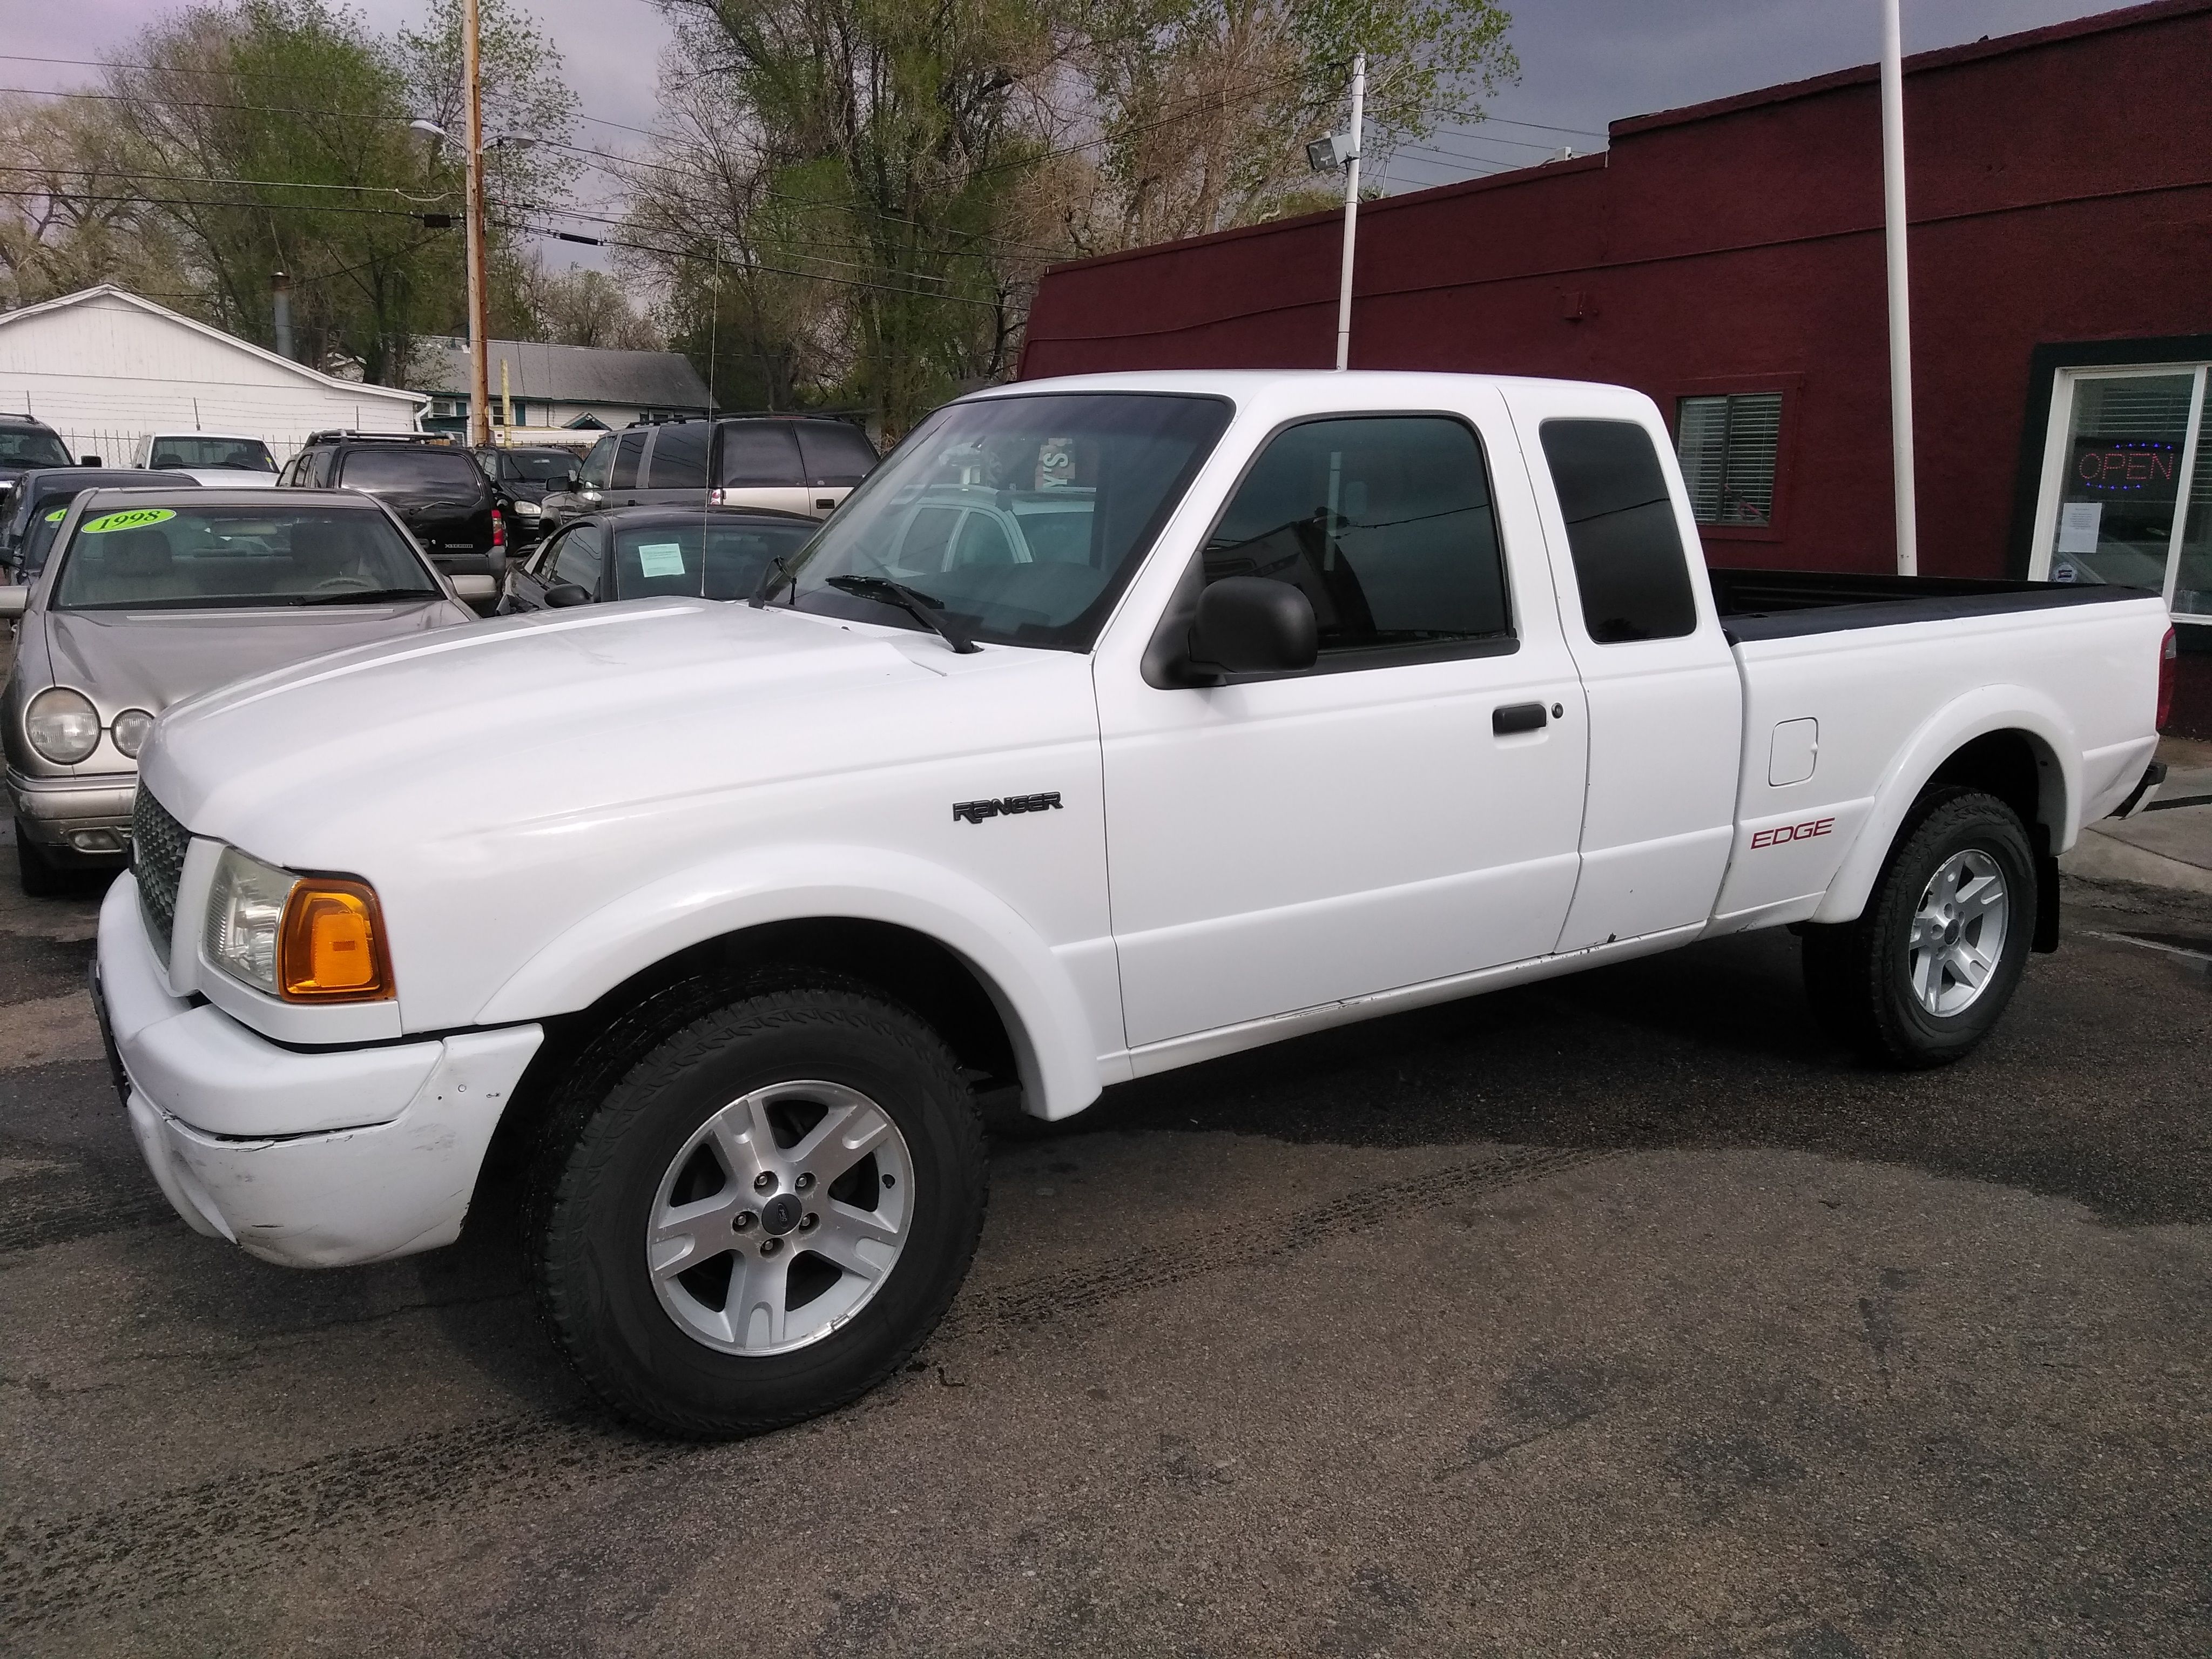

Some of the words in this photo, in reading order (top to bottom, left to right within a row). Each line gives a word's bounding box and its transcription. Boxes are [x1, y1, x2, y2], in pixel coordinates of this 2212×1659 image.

[2079, 453, 2174, 480] OPEN
[96, 510, 161, 530] 1998
[953, 791, 1064, 824] RANGER
[1750, 817, 1836, 849] EDGE
